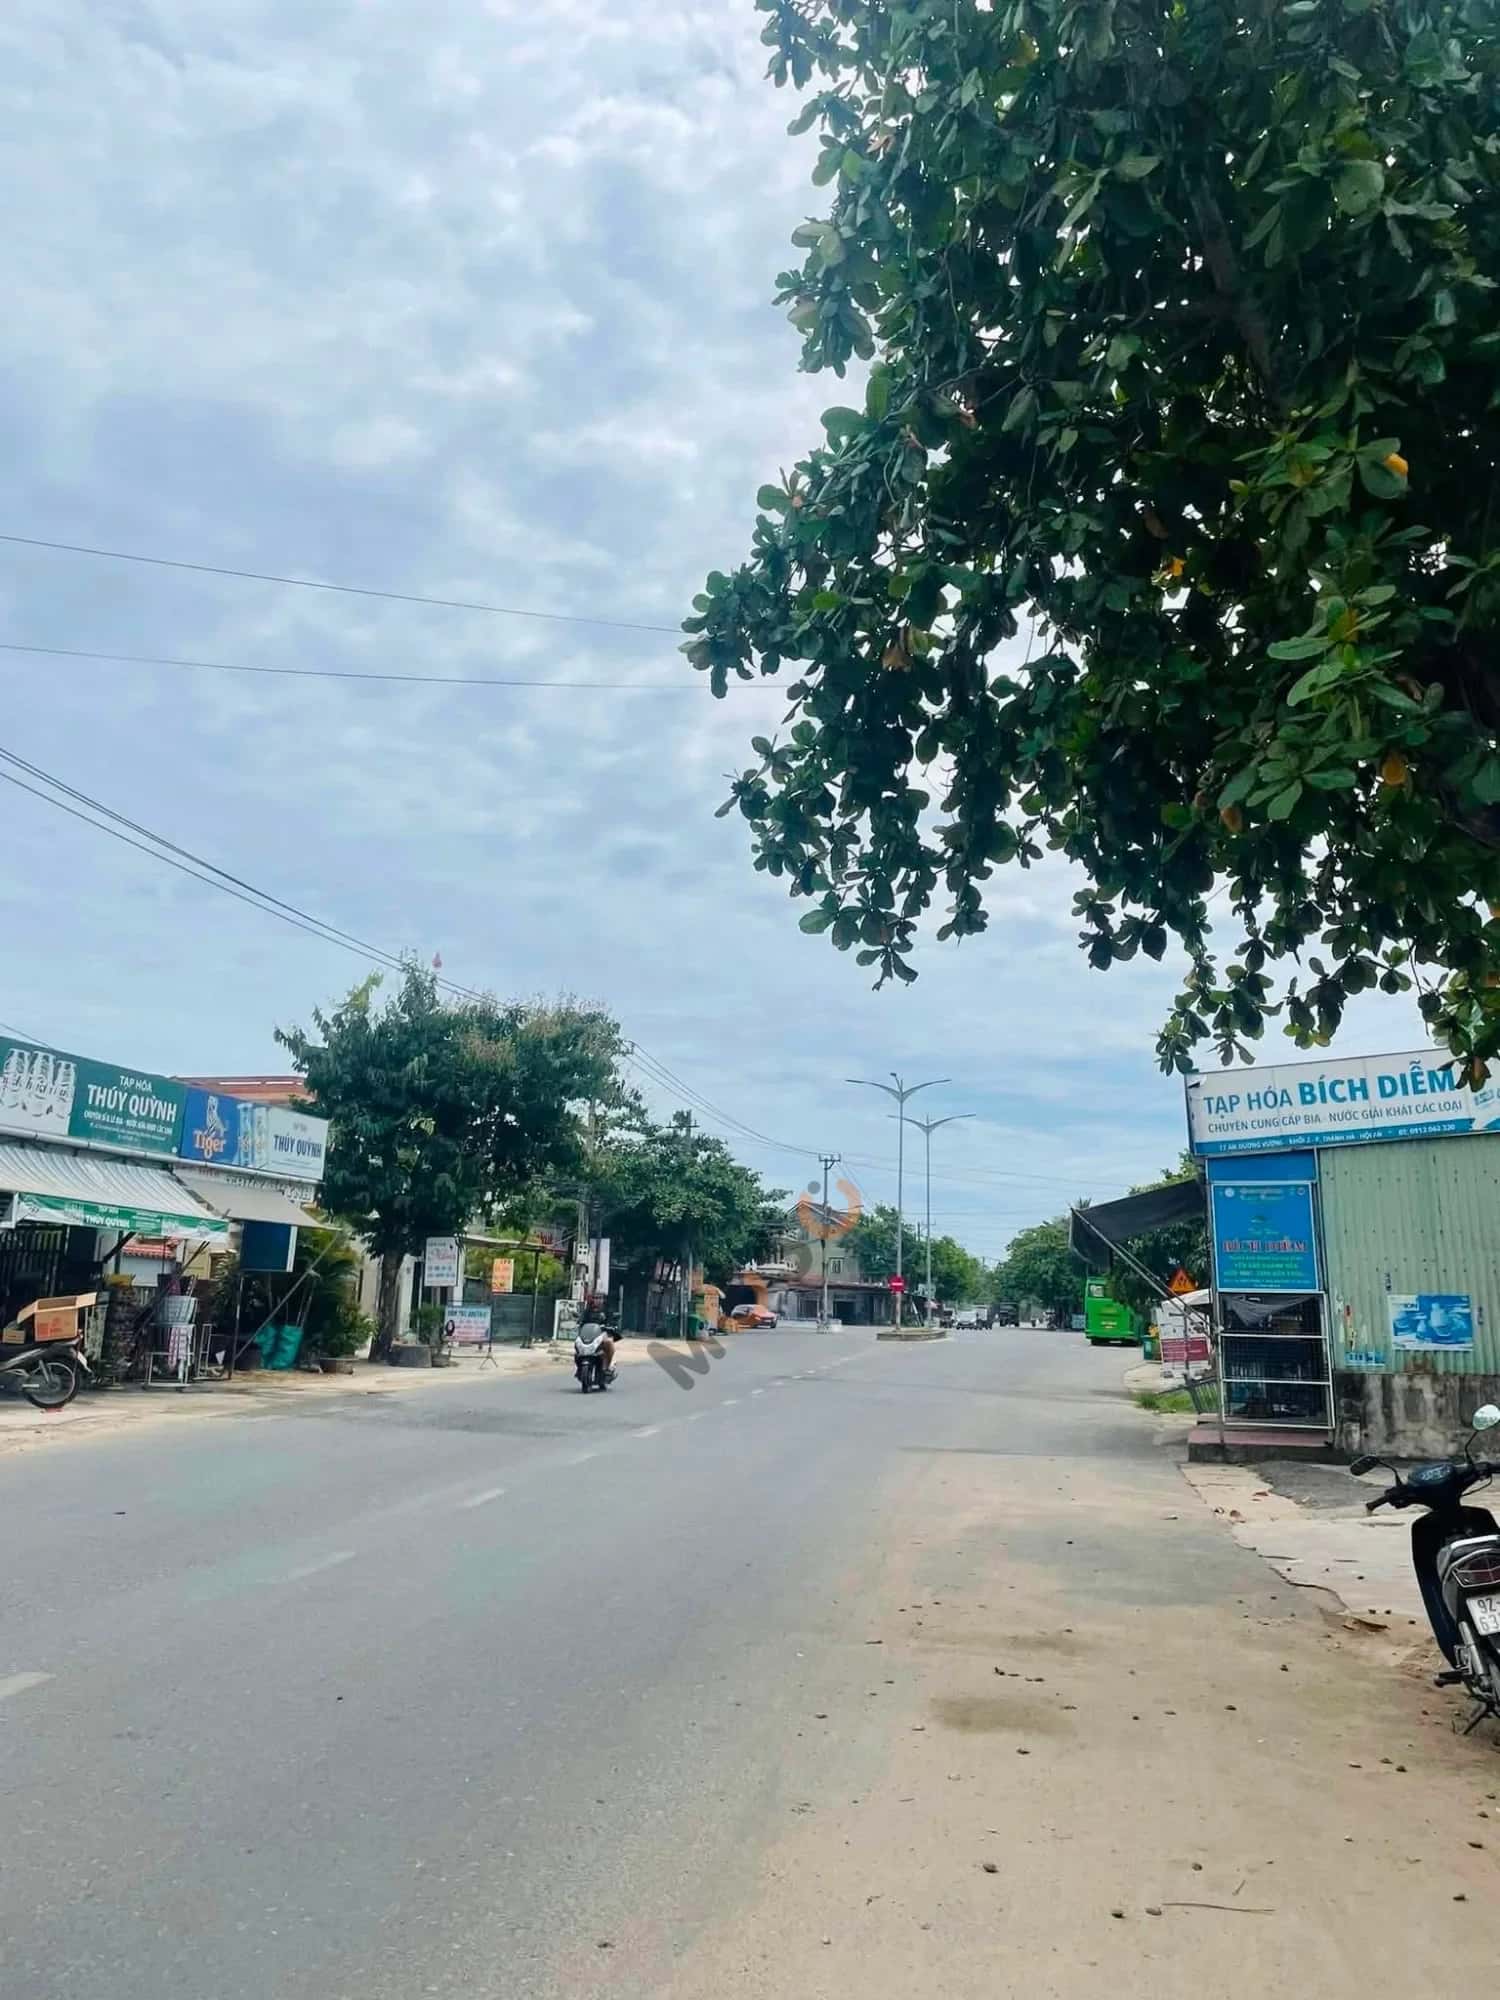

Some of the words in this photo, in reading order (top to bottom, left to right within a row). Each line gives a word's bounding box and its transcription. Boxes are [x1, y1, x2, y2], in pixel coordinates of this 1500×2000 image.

[119, 1075, 135, 1090] TẠP
[1203, 1094, 1241, 1119] TẠP
[1247, 1085, 1293, 1111] HÓA
[1298, 1074, 1370, 1106] BÍCH
[1377, 1059, 1457, 1099] DIỄM
[87, 1084, 128, 1112] THÚY
[129, 1094, 177, 1123] QUỲNH
[1251, 1117, 1280, 1130] CUNG
[1304, 1113, 1321, 1125] BIA
[1415, 1101, 1436, 1114] CÁC
[193, 1129, 227, 1160] Tiger
